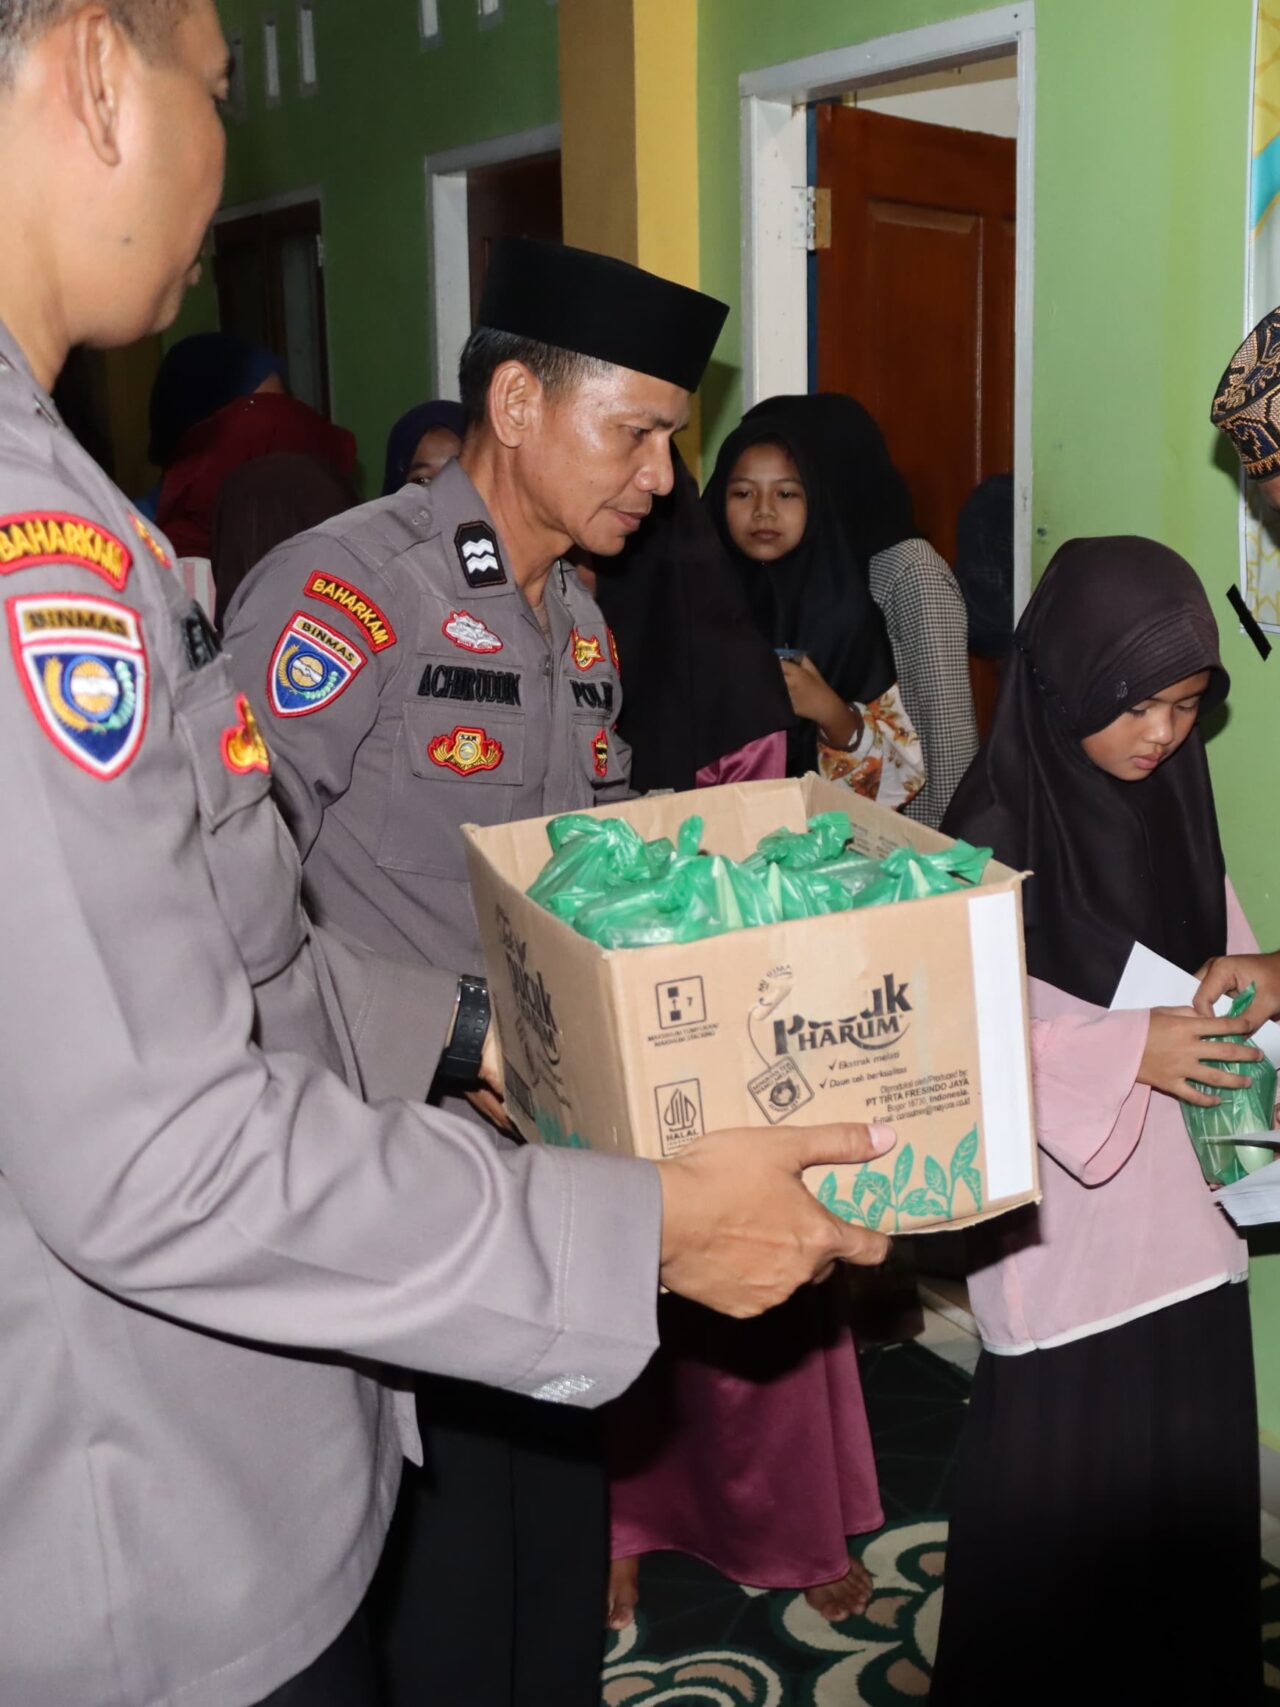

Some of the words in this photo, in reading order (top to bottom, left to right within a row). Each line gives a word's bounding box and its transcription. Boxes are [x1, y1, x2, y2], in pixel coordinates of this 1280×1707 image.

[28, 609, 130, 637] BINMAS
[312, 578, 389, 645] BAHARKAM
[301, 621, 355, 662] BINMAS
[799, 1015, 900, 1051] HARUM
[865, 1097, 877, 1107] PT
[879, 1093, 903, 1104] TIRTA
[904, 1085, 947, 1099] FRESINDO
[948, 1077, 970, 1090] JAYA
